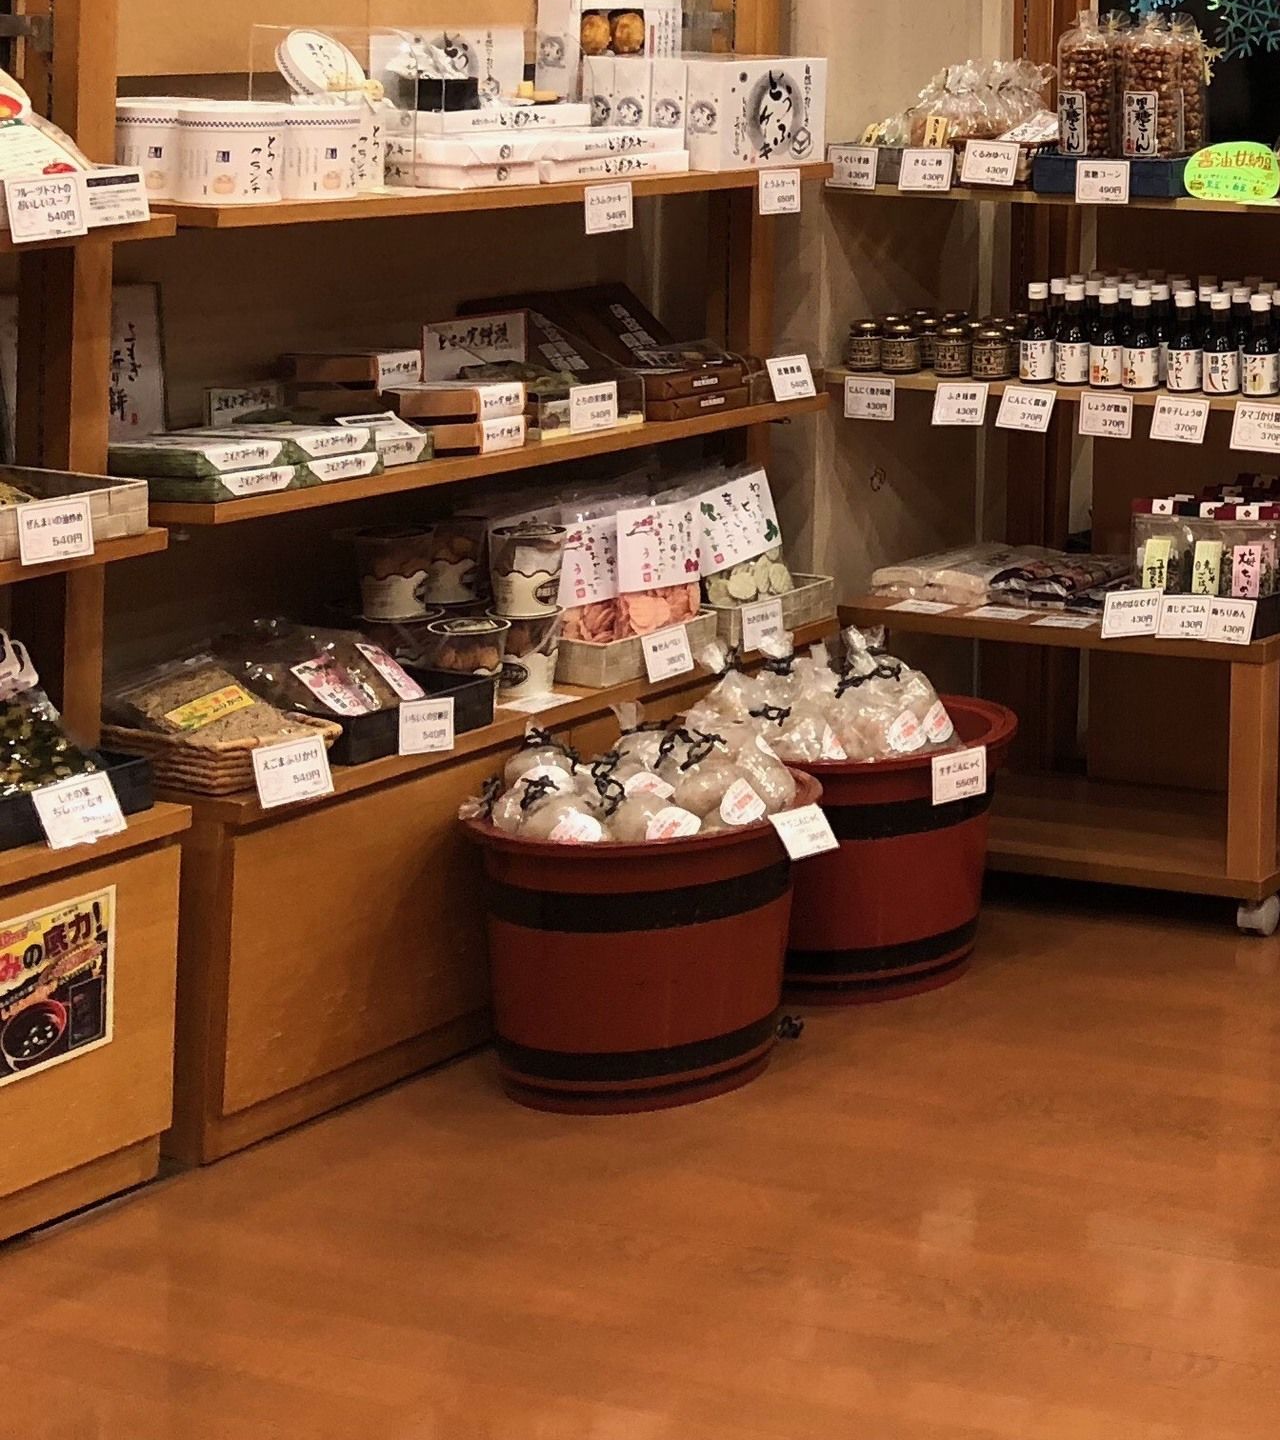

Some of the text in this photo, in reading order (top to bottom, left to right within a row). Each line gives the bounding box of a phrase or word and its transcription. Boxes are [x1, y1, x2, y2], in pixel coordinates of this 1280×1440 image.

[971, 149, 1012, 161] くるみゆべし
[984, 165, 1009, 176] 430円
[921, 173, 945, 182] 430円
[763, 179, 797, 190] とうふケーキ
[589, 194, 628, 206] とうふクッキー
[47, 210, 76, 222] 540円
[1028, 342, 1039, 378] にんにく
[1019, 412, 1043, 423] 370円
[1101, 418, 1125, 429] 370円
[1173, 422, 1198, 434] 370円
[51, 532, 83, 548] 540円
[1222, 624, 1245, 635] 430円
